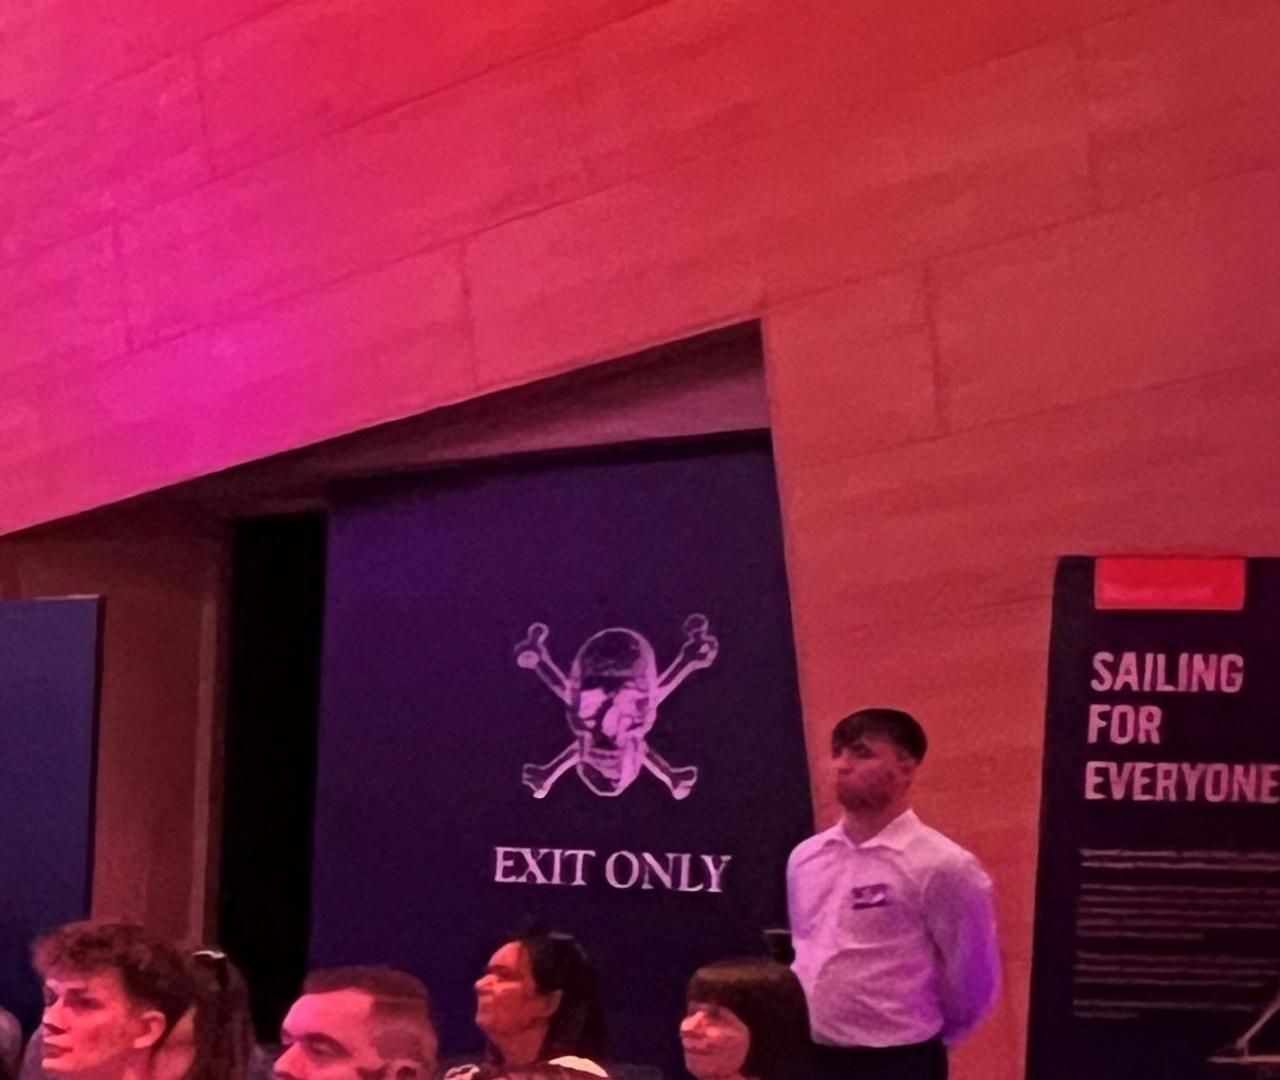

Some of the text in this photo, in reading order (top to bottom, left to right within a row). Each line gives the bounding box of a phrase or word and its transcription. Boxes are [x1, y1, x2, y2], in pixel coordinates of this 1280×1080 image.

[1090, 651, 1245, 694] SAILING
[1087, 703, 1163, 744] FOR
[1084, 760, 1280, 804] EVERYONE
[493, 846, 733, 893] EXIT ONLY
